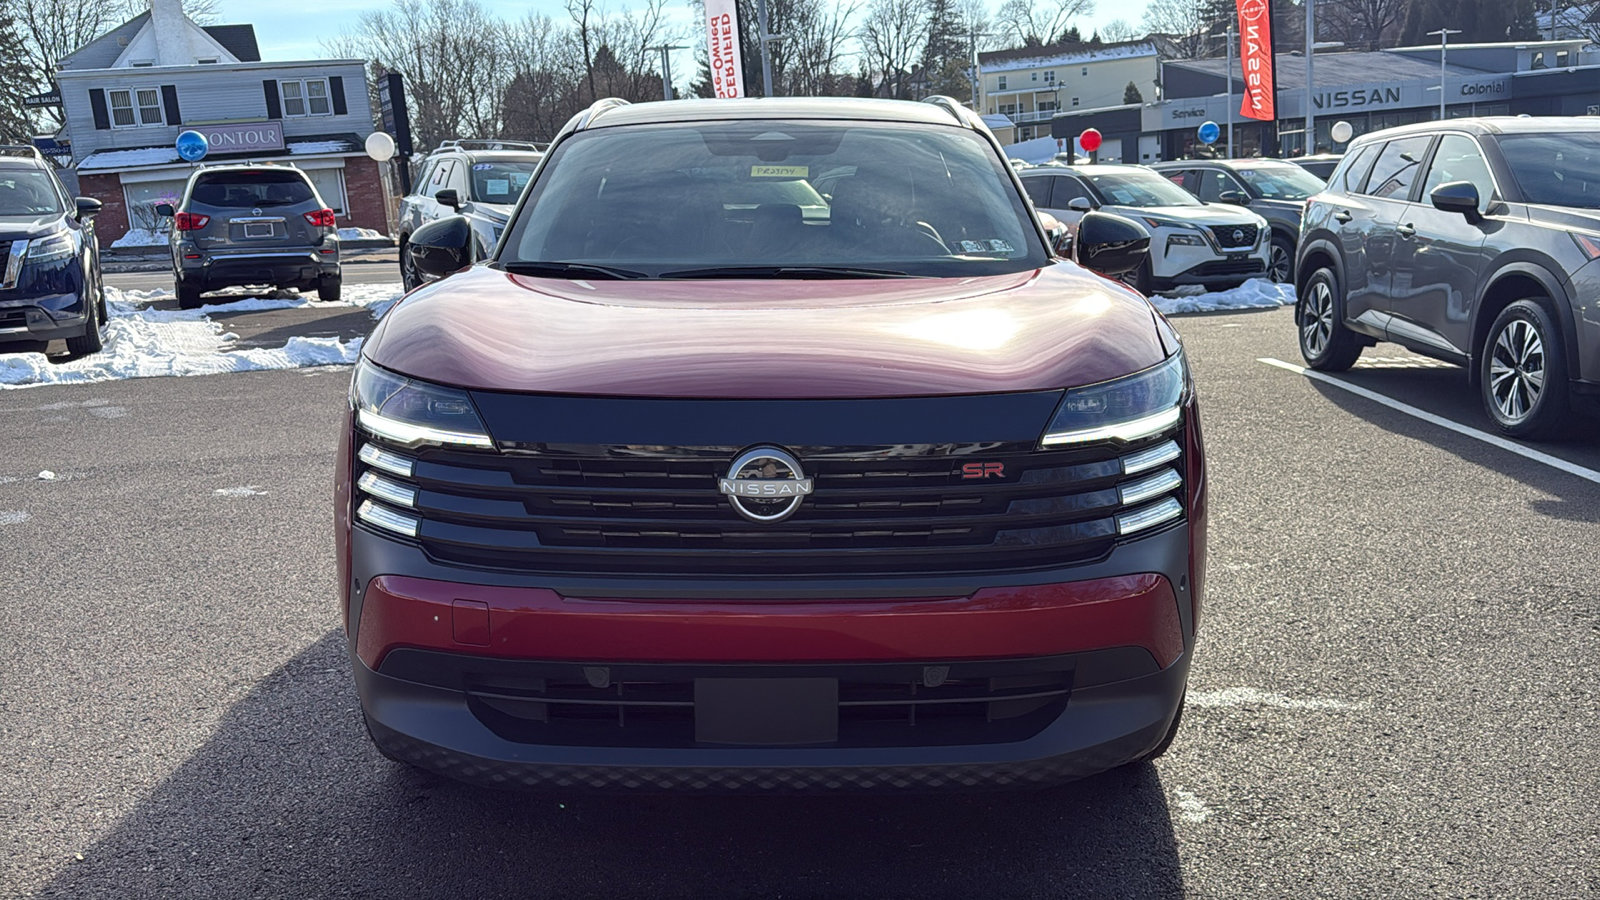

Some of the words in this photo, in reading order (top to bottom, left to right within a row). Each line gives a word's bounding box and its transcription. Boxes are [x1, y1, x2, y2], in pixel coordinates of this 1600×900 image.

[1461, 81, 1505, 96] Colonial
[1312, 87, 1400, 109] NISSAN
[1172, 108, 1205, 119] Service
[206, 129, 277, 147] ONTOUR
[963, 462, 1006, 479] SR
[723, 481, 809, 495] NISSAN
